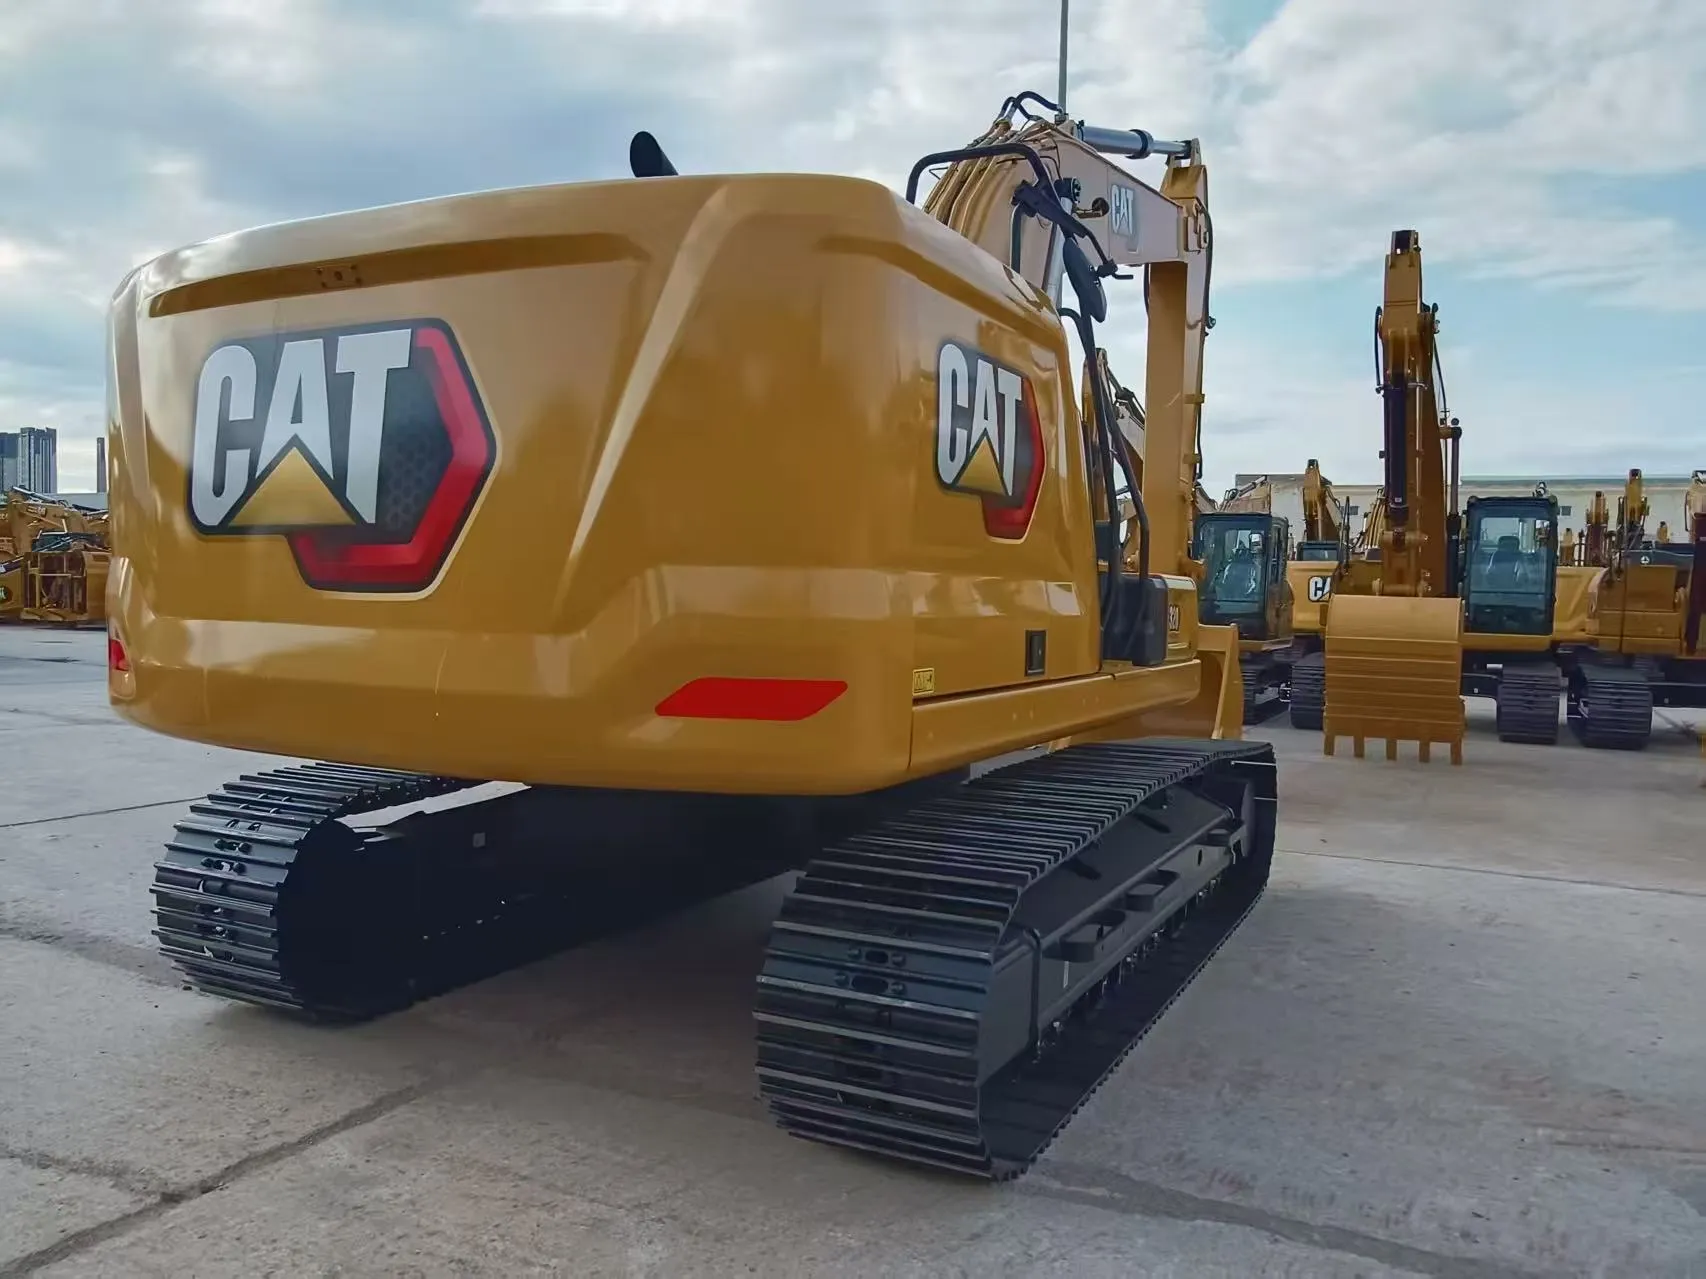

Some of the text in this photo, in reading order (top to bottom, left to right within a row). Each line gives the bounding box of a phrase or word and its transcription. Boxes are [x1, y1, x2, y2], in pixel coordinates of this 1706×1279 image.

[1111, 184, 1134, 235] CAT
[192, 328, 412, 526] CAT
[937, 343, 1022, 496] CAT
